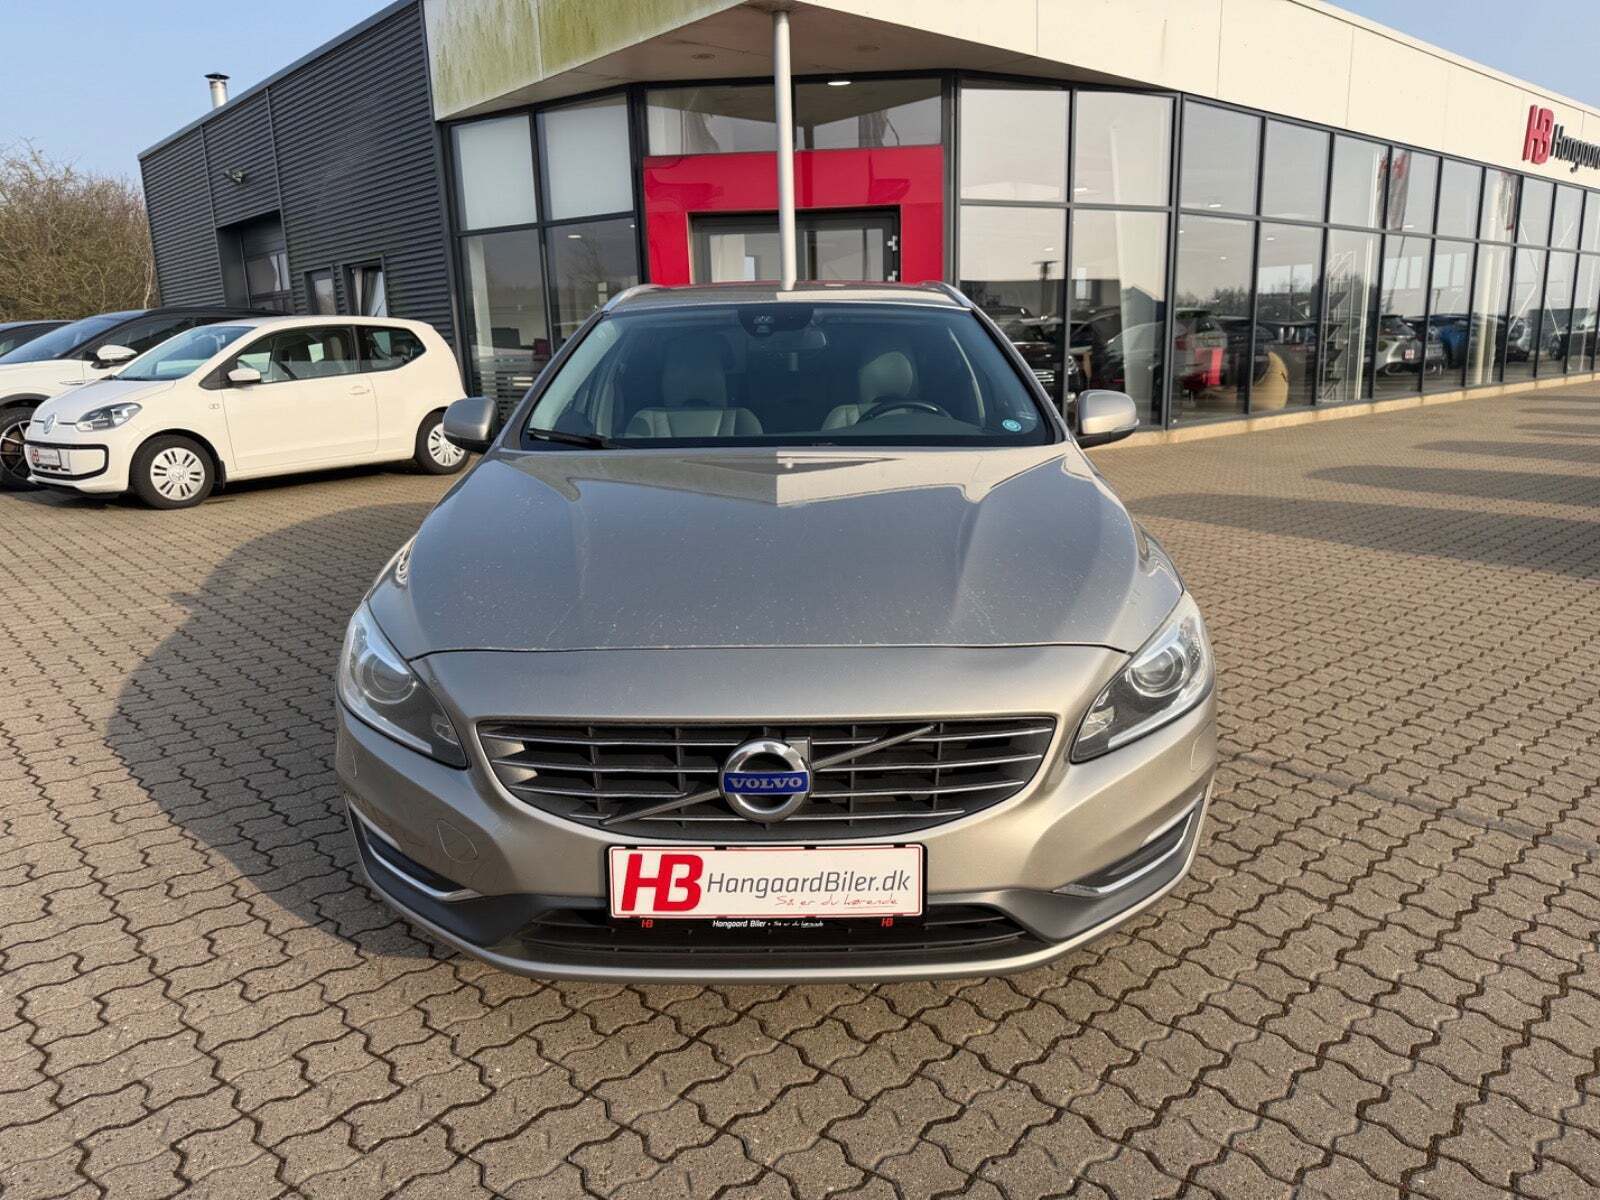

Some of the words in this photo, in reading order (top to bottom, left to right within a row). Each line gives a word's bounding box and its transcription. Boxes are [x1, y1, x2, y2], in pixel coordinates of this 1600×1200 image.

[1522, 105, 1554, 165] HB
[1550, 124, 1600, 174] Hangaar
[728, 777, 802, 789] VOLVO
[621, 853, 704, 912] HB
[707, 870, 911, 899] HangaardBiler.dk
[800, 898, 816, 906] er
[821, 894, 838, 906] du
[641, 919, 654, 929] HB
[712, 919, 748, 930] Hangaard
